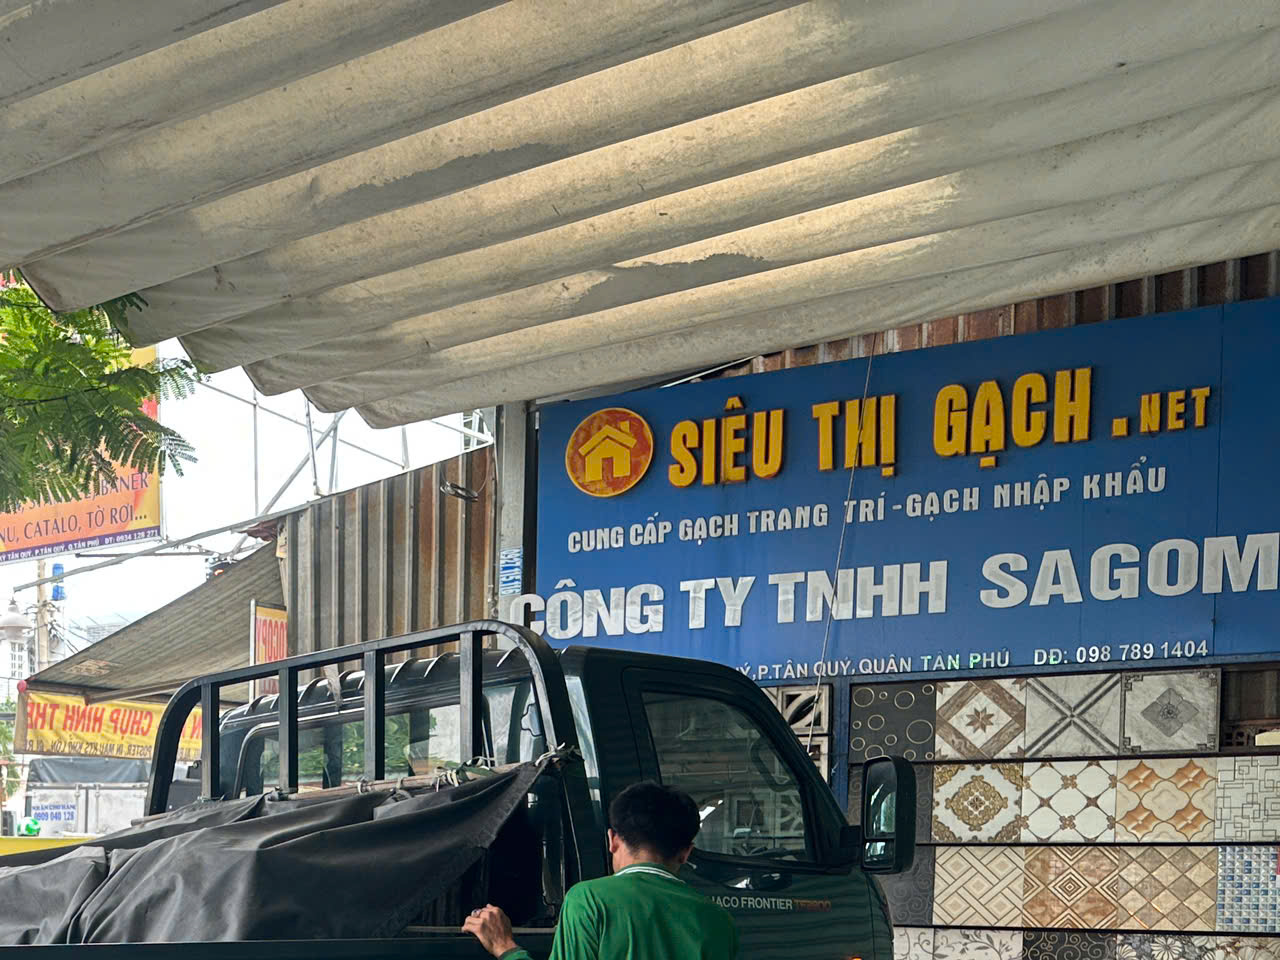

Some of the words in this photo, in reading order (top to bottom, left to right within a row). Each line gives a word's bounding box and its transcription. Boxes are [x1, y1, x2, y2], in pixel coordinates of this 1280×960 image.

[668, 395, 785, 487] SIÊU
[812, 394, 897, 478] THỊ
[933, 367, 1093, 468] GẠCH
[100, 472, 149, 495] BANER
[24, 513, 82, 539] CATALO,
[87, 505, 104, 528] TỜ
[568, 526, 624, 553] CUNG
[629, 512, 672, 545] CẤP
[678, 513, 739, 545] GẠCH
[747, 503, 828, 534] TRANG
[844, 491, 885, 523] TRÍ
[993, 473, 1070, 510] NHẬP
[1082, 456, 1167, 500] KHẨU
[510, 578, 665, 640] CÔNG
[679, 575, 756, 630] TY
[768, 560, 948, 624] TNHH
[813, 656, 856, 678] QUÝ,
[920, 650, 960, 672] TÂN
[969, 647, 1011, 669] PHÚ
[1076, 645, 1111, 663] 098
[1119, 643, 1154, 662] 789
[1160, 640, 1208, 659] 1404
[740, 896, 793, 910] FRONTIER
